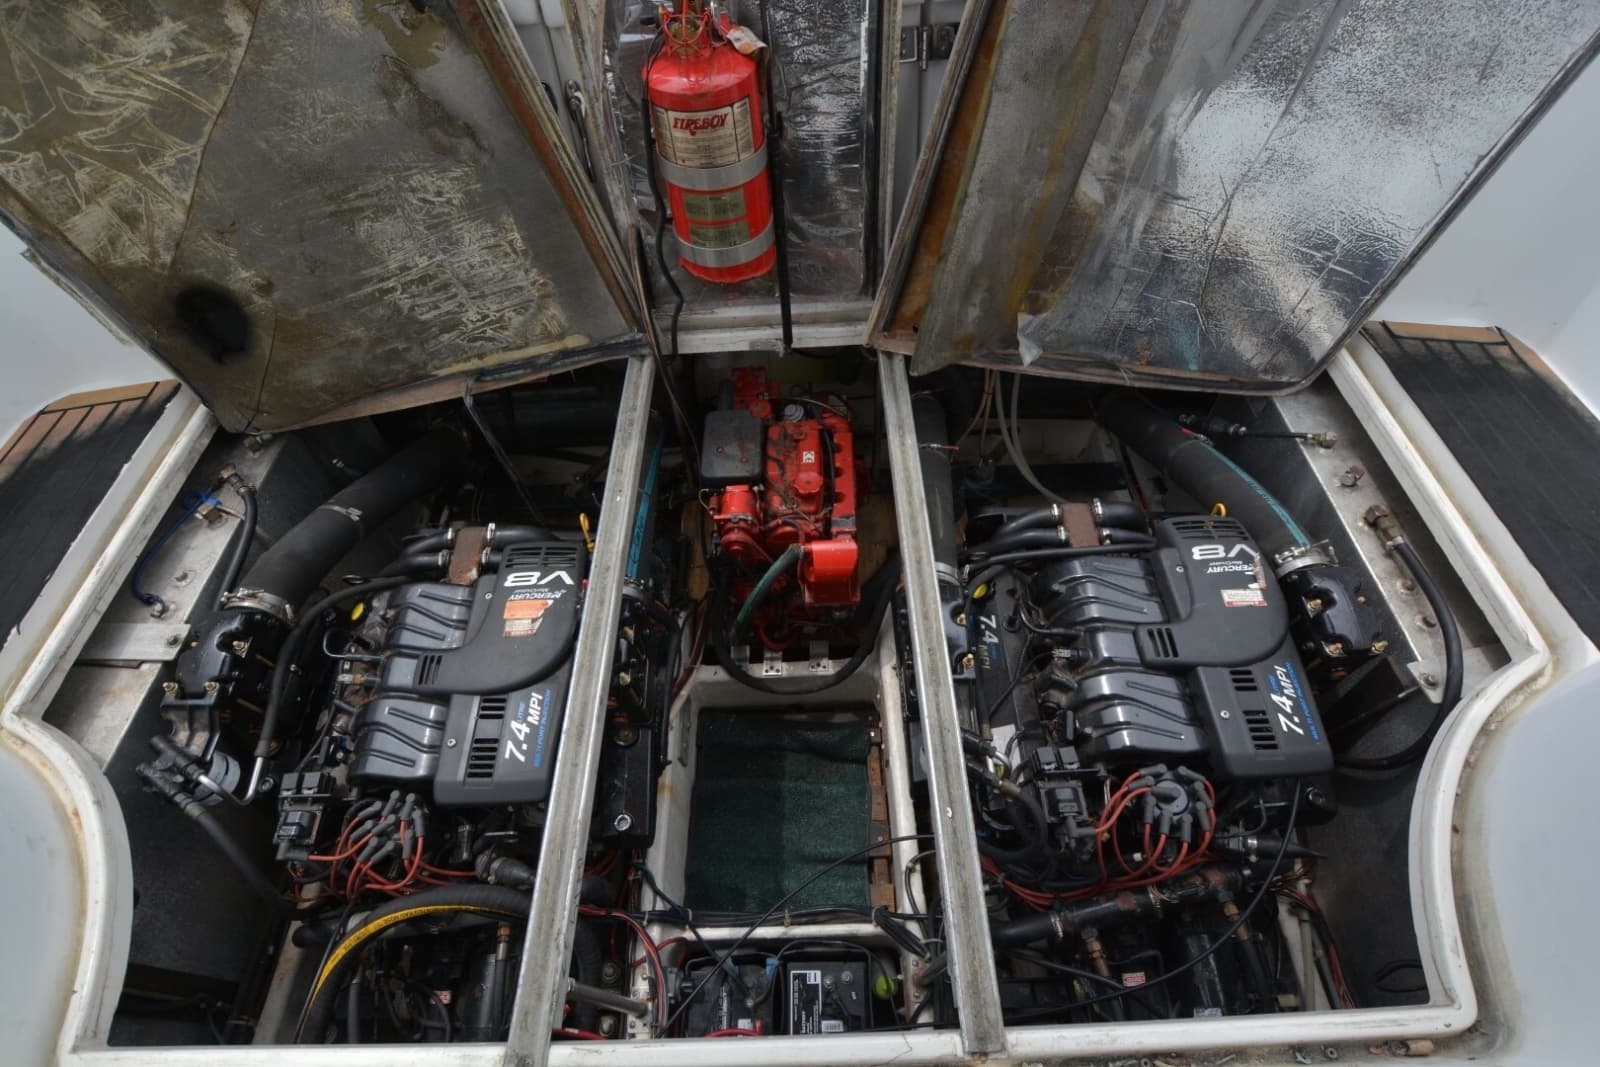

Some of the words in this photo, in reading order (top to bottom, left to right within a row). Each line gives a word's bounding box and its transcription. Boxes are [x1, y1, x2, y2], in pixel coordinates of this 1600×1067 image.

[673, 113, 728, 136] FIREBOY
[1192, 544, 1259, 560] V8
[503, 570, 574, 587] V8
[1274, 665, 1297, 698] MPI
[526, 692, 543, 726] MPI
[1270, 692, 1305, 736] 7.4
[505, 719, 532, 763] 7.4
